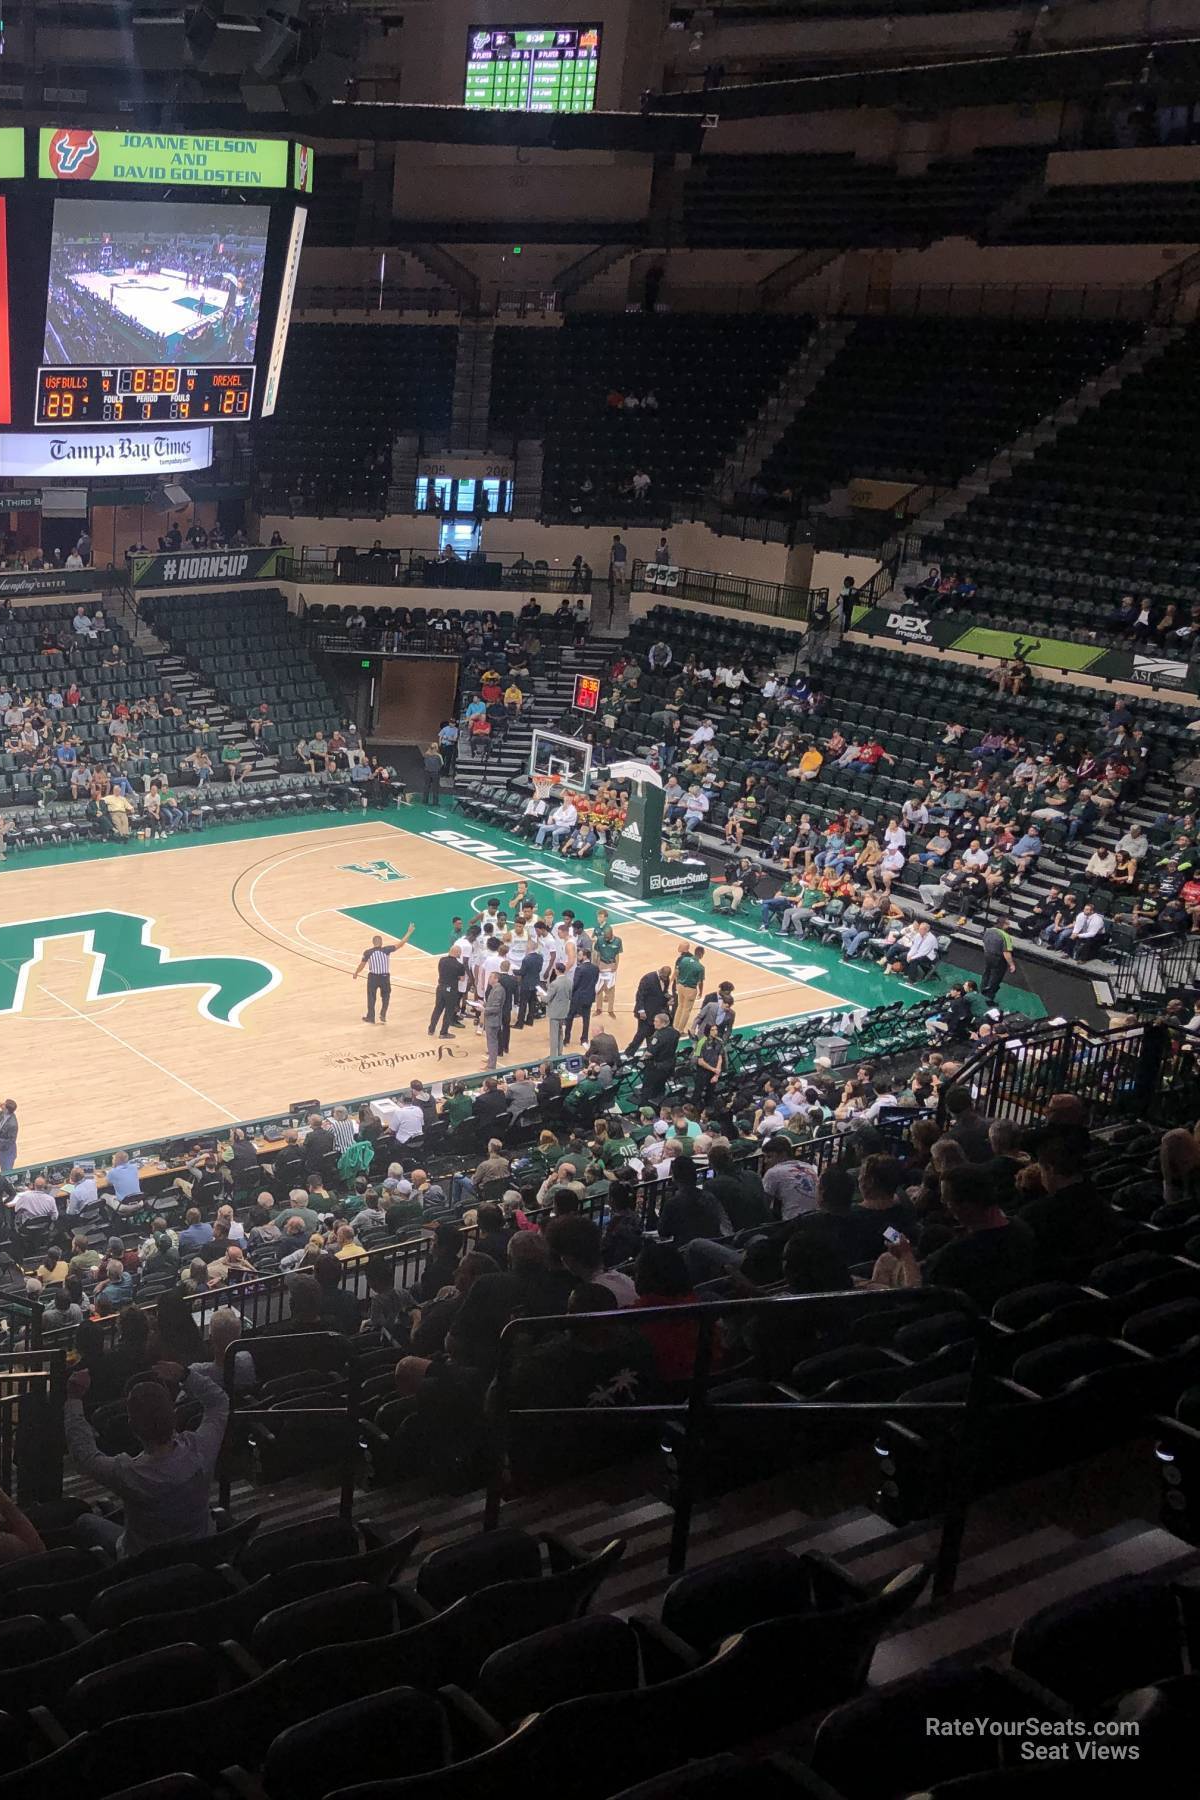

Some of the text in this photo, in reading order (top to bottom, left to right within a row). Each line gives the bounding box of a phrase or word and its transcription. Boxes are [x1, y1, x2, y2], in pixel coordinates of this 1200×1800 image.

[120, 135, 257, 154] JOANNE NELSON
[171, 153, 207, 166] AND
[113, 165, 262, 184] DAVID GOLDSTEIN
[134, 369, 176, 392] 8:36
[212, 375, 242, 386] DREXEL
[48, 393, 74, 417] 23
[103, 395, 123, 403] FOULS
[136, 395, 158, 403] PERIOD
[170, 394, 190, 402] FOULS
[223, 390, 248, 414] 21
[50, 436, 191, 466] Tampa Bay Times
[6, 498, 32, 508] THIRD
[163, 555, 248, 580] #HORNSUP
[37, 580, 66, 589] CENTER
[886, 613, 931, 634] DEX
[895, 628, 933, 642] imaging
[1131, 670, 1152, 682] ASI
[576, 687, 595, 708] 27
[661, 872, 708, 888] CenterState
[419, 829, 829, 982] SOUTH FLORIDA
[359, 1044, 469, 1074] Yuengling
